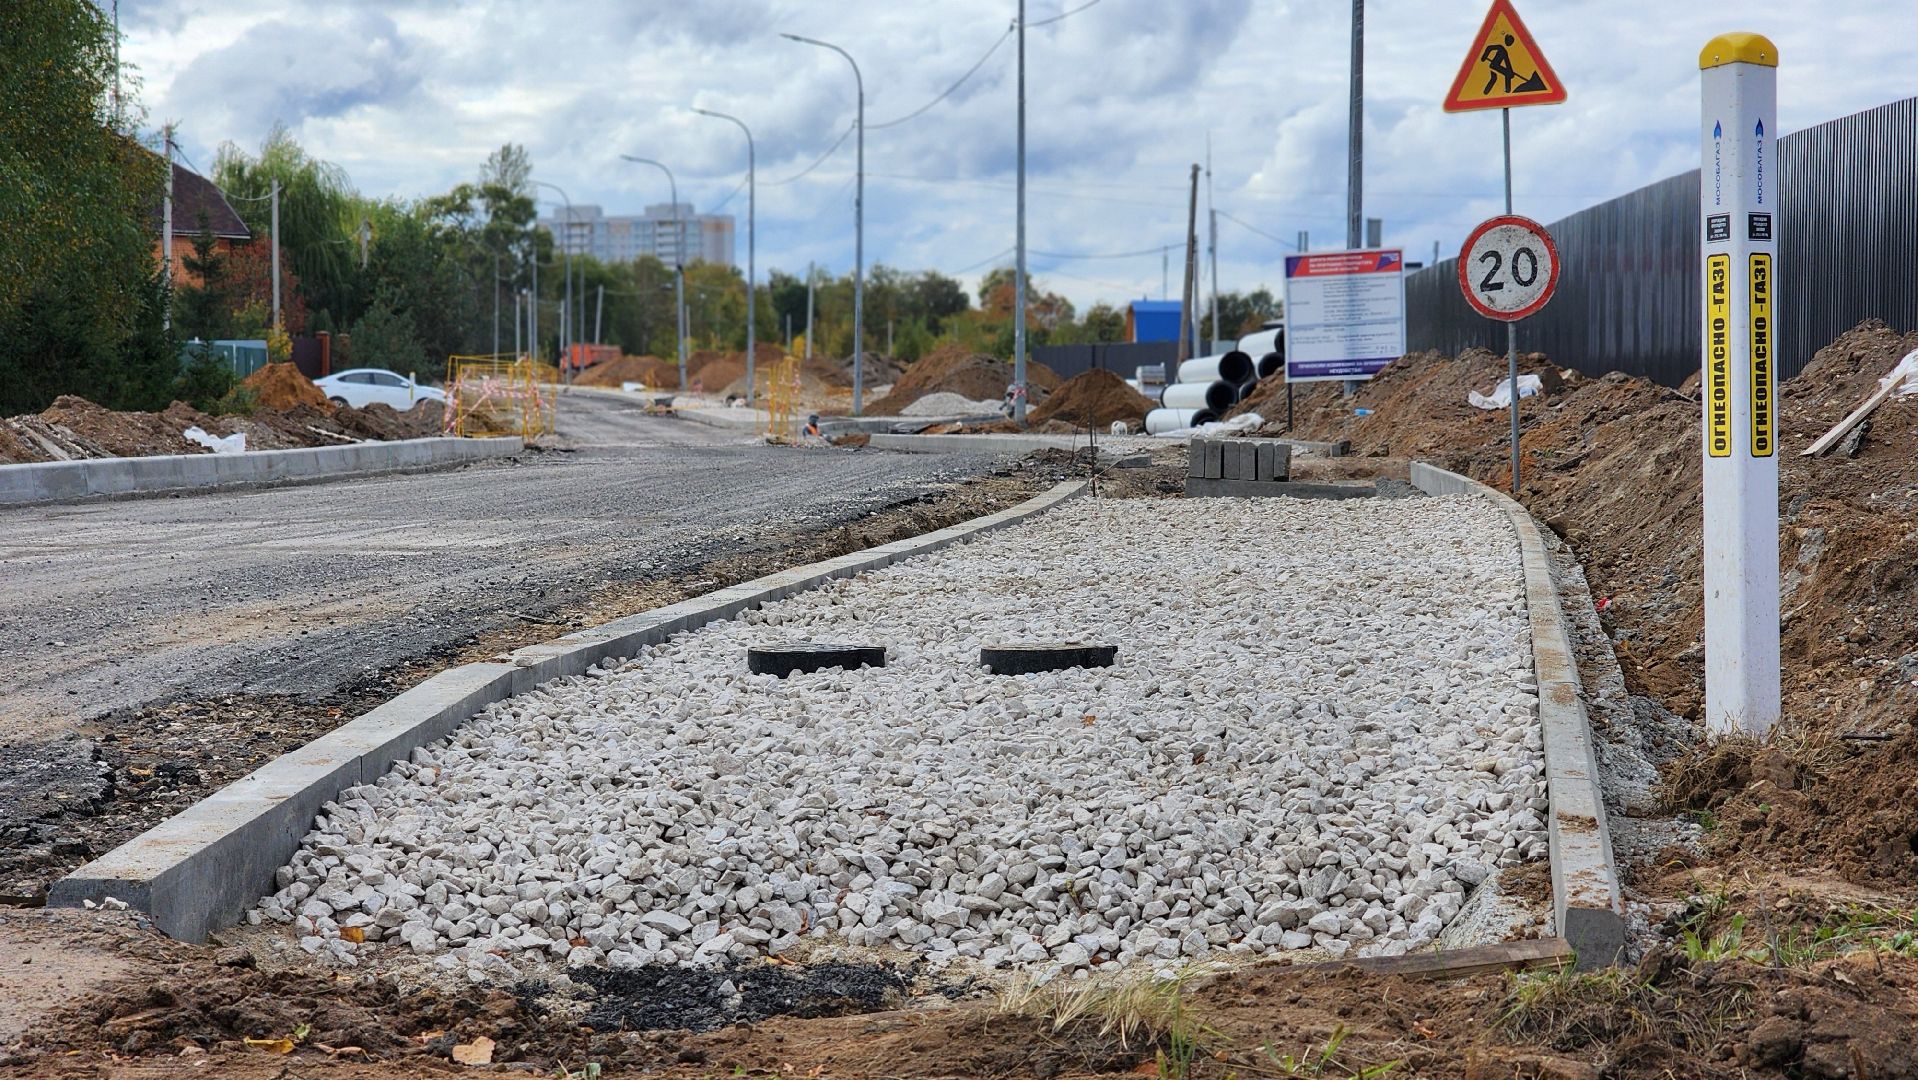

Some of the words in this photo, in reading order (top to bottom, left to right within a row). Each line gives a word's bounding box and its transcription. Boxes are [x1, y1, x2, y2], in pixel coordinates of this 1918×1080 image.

[1479, 247, 1538, 292] 20
[1713, 318, 1726, 450] ОГНЕОПАСНО
[1755, 317, 1767, 450] ОГНЕОПАСНО
